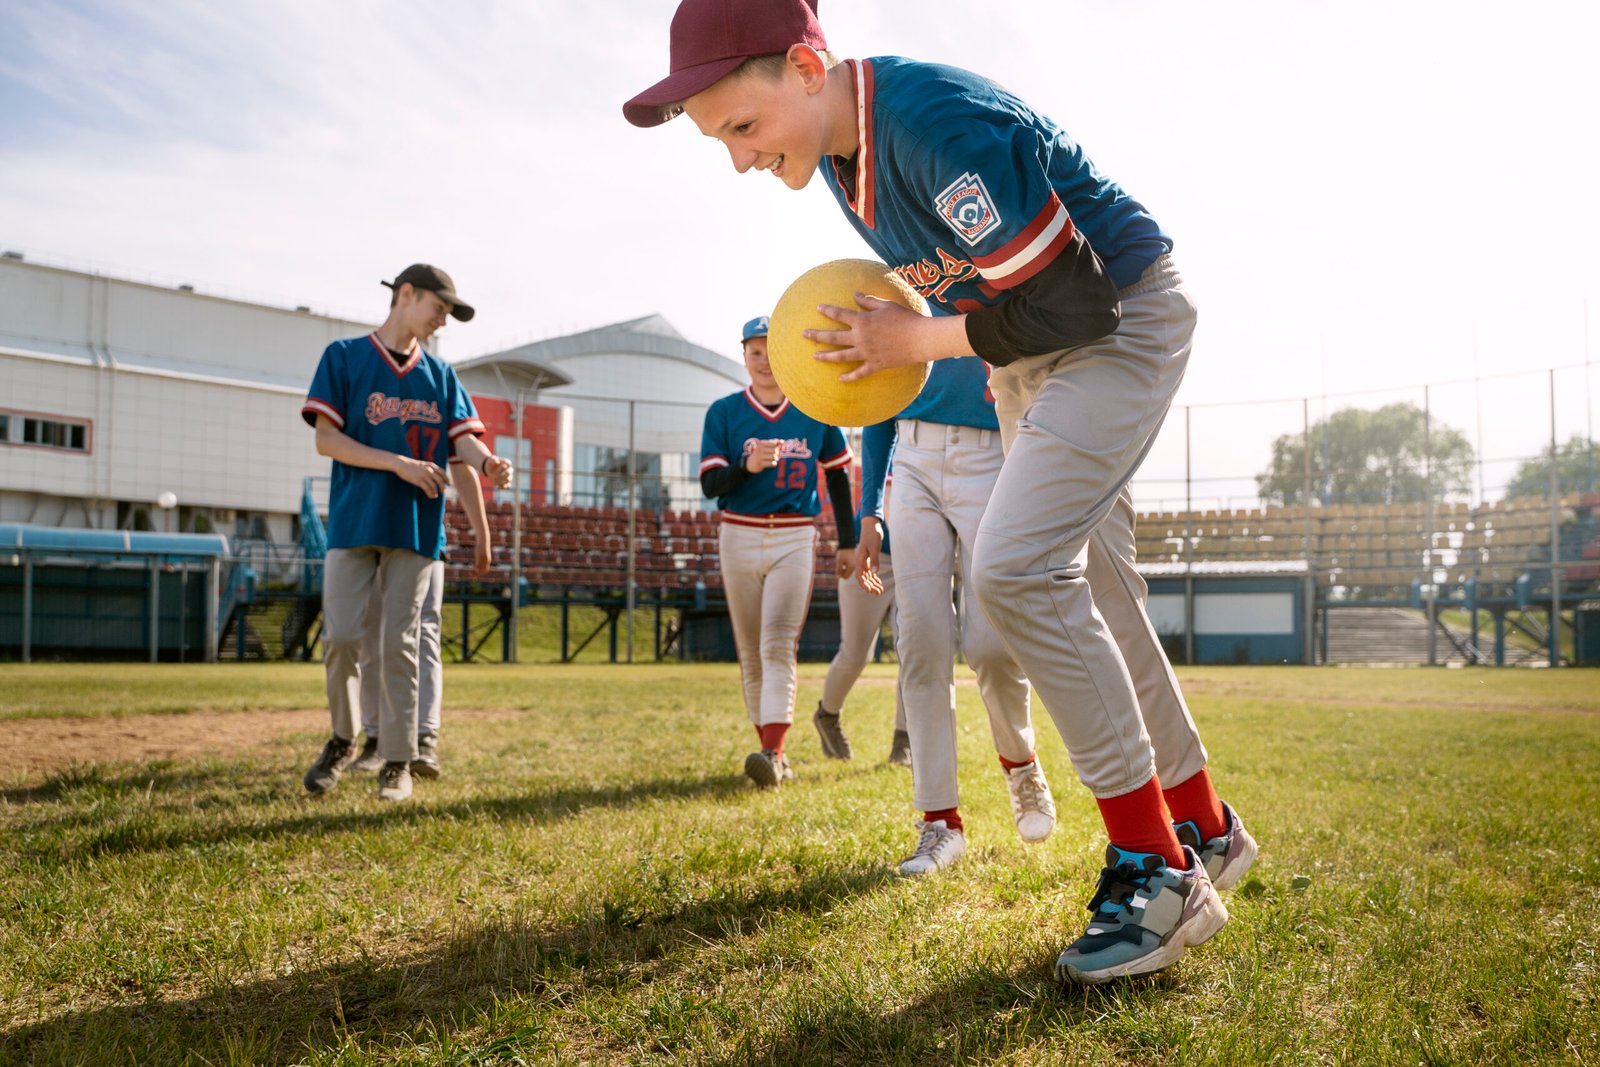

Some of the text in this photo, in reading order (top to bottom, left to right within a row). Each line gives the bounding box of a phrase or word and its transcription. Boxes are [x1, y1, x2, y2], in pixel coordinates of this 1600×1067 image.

[365, 391, 442, 426] Rangers
[405, 424, 441, 462] 17
[774, 459, 807, 490] 12
